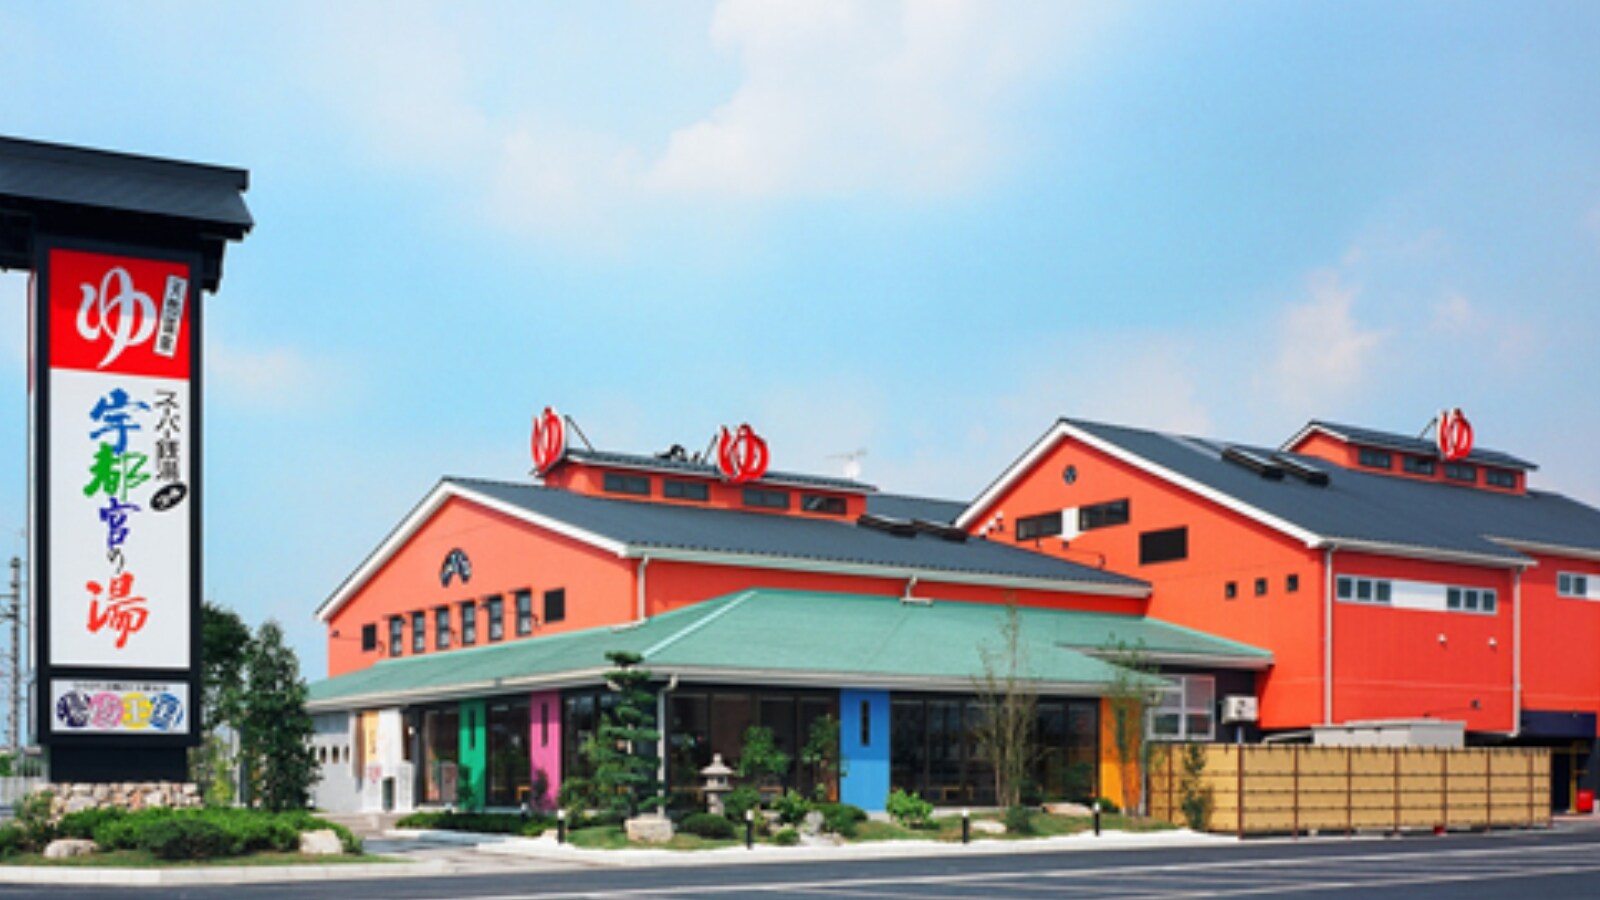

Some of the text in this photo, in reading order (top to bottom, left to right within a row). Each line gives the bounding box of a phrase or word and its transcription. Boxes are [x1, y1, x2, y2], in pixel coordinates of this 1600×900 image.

[75, 266, 157, 370] ゆ
[531, 405, 566, 474] ゆ
[716, 422, 769, 484] ゆ
[84, 387, 151, 649] 宇都宮の湯
